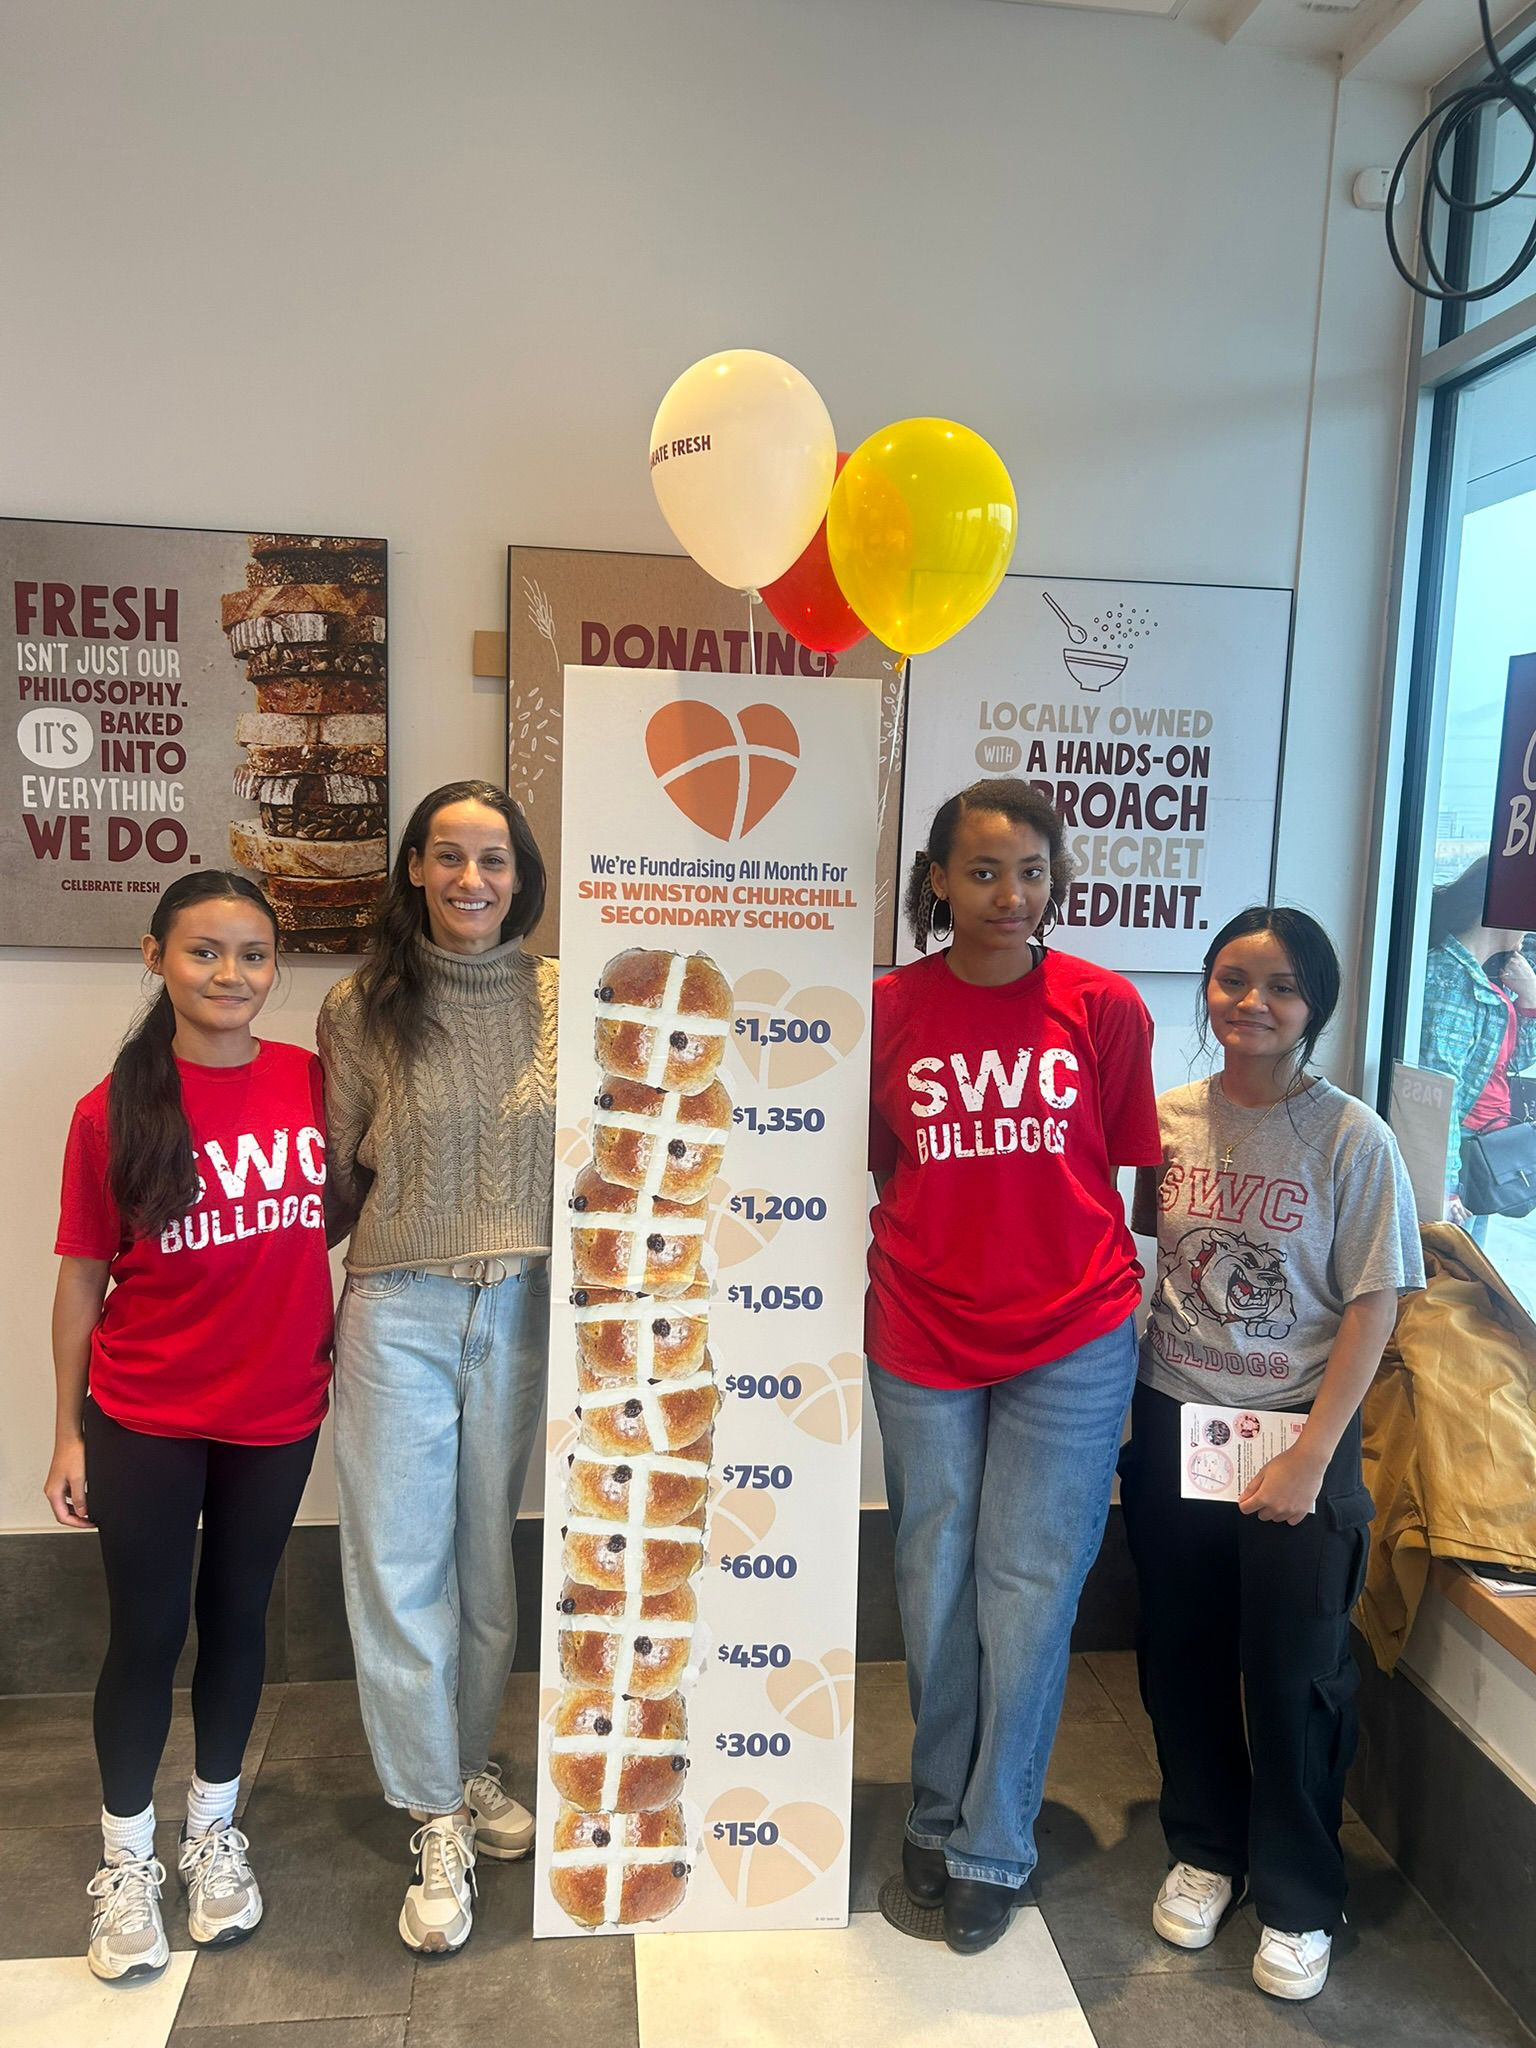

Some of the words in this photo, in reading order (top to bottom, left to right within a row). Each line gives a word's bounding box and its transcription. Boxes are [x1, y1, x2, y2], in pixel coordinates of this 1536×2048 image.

[672, 434, 711, 458] FRESH
[14, 580, 179, 643] FRESH
[17, 641, 69, 674] ISN'T
[77, 644, 129, 676] JUST
[137, 648, 181, 679] OUR
[581, 621, 835, 678] DONATING
[18, 675, 188, 708] PHILOSOPHY.
[100, 710, 183, 736] BAKED
[979, 701, 1100, 734] LOCALLY
[1108, 706, 1213, 738] OWNED
[34, 721, 78, 755] IT'S
[101, 739, 187, 775] INTO
[984, 745, 1014, 764] WITH
[1025, 740, 1048, 773] A
[1055, 740, 1210, 779] HANDS-ON
[22, 775, 185, 813] EVERYTHING
[22, 813, 91, 861] WE
[108, 816, 201, 865] DO.
[640, 856, 736, 882] Fundraising
[739, 859, 761, 881] All
[764, 860, 819, 882] Month
[822, 862, 848, 883] For
[1072, 834, 1204, 880] SECRET
[61, 879, 123, 893] CELEBRATE
[127, 881, 160, 894] FRESH
[578, 880, 617, 901] SIR
[621, 882, 729, 905] WINSTON
[732, 885, 858, 908] CHURCHILL
[600, 905, 741, 928] SECONDARY
[743, 910, 835, 931] SCHOOL
[734, 1018, 832, 1047] $1,500
[906, 1047, 1079, 1118] SWC
[732, 1106, 826, 1136] $1,350
[729, 1195, 828, 1225] $1,200
[1158, 1164, 1309, 1233] SWC
[160, 1193, 326, 1254] BULLDOG
[727, 1284, 824, 1314] $1,050
[724, 1374, 802, 1400] $900
[722, 1464, 794, 1490] $750
[720, 1554, 798, 1580] $600
[717, 1643, 792, 1669] $450
[715, 1732, 792, 1757] $300
[712, 1821, 780, 1846] $150
